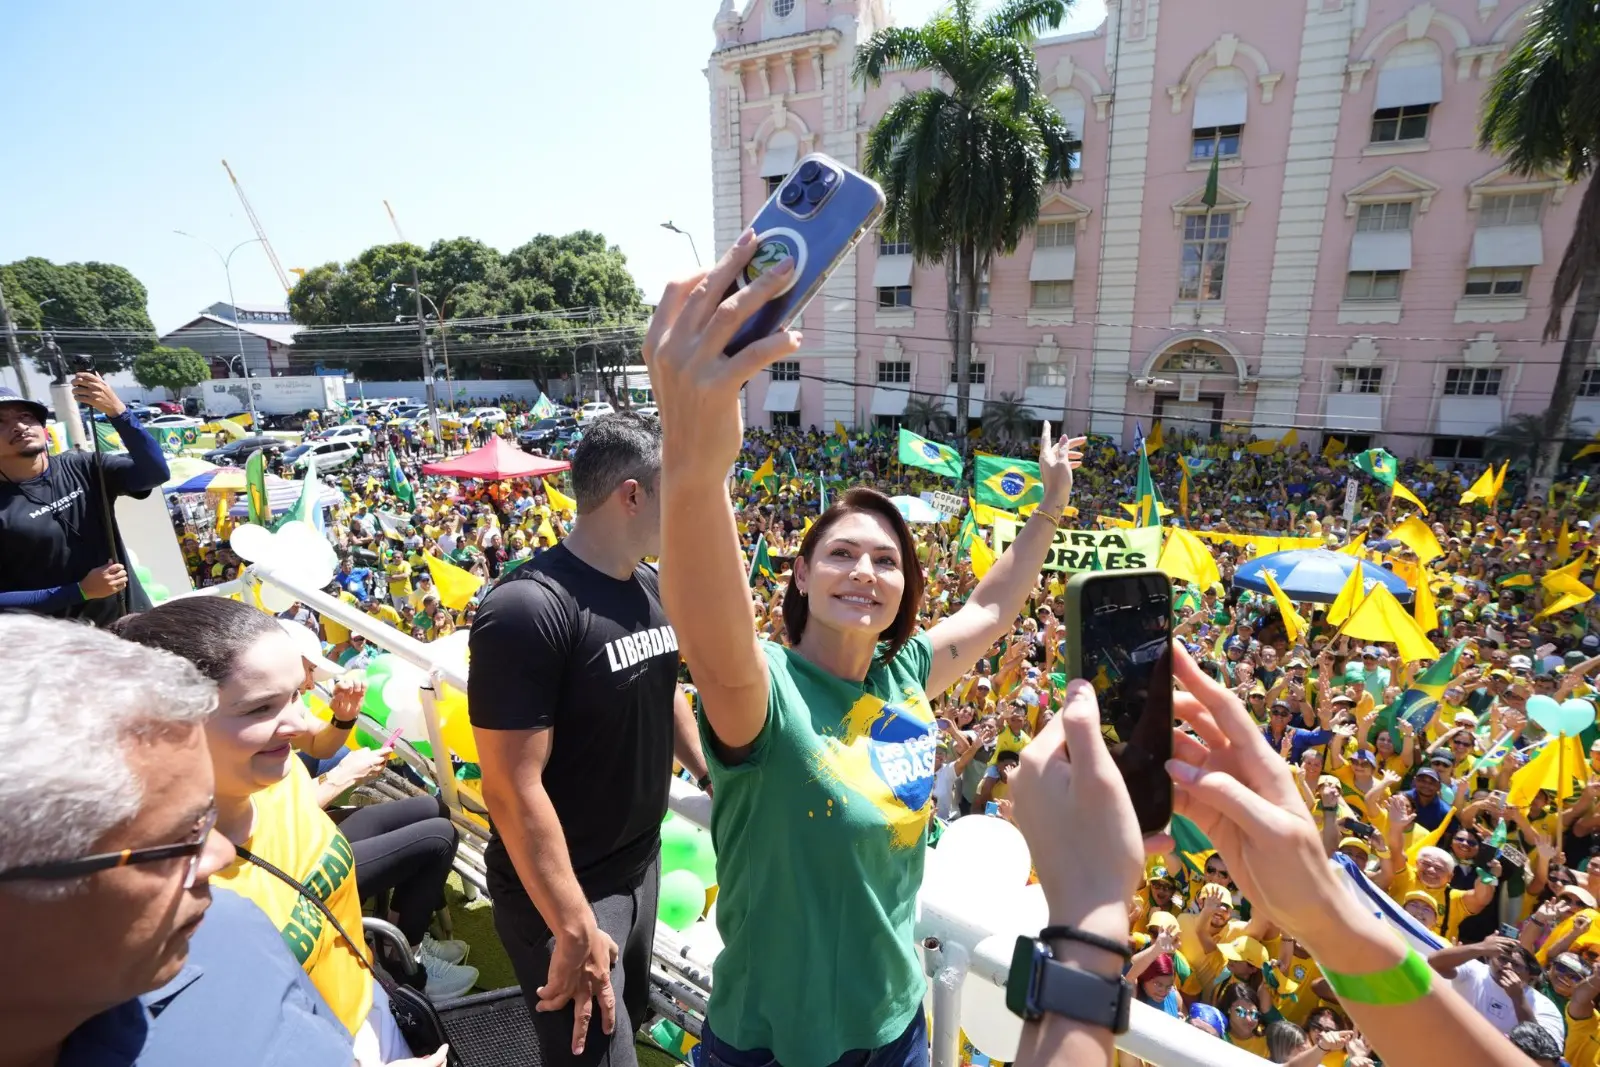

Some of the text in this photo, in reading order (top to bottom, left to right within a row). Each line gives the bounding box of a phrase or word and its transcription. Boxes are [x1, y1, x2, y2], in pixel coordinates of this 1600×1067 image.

[1001, 540, 1147, 570] RAES
[605, 625, 679, 673] LIBERDA
[880, 751, 936, 787] BRAS
[280, 833, 354, 966] BEDAD
